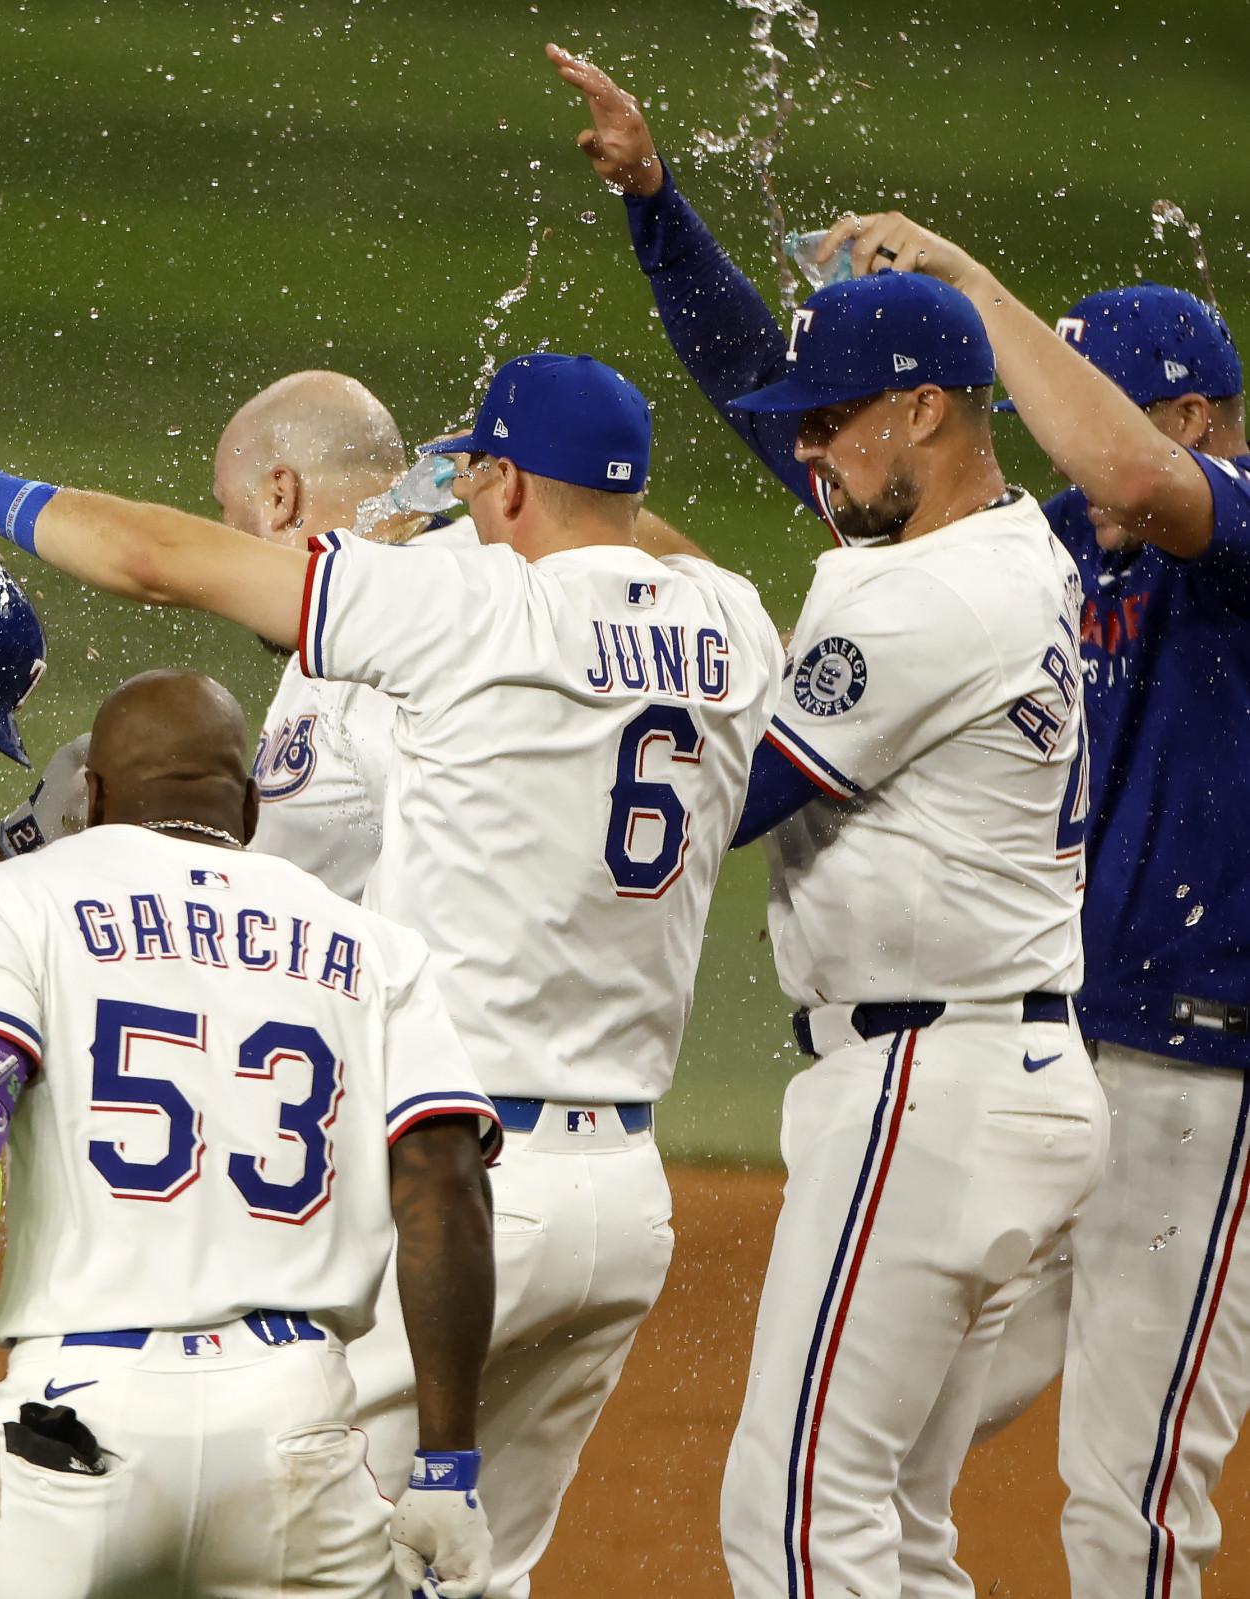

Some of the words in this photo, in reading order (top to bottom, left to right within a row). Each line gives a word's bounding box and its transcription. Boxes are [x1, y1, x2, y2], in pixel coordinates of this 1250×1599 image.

[7, 513, 15, 527] THE
[11, 487, 30, 513] RESULT
[584, 619, 729, 702] JUNG
[795, 663, 855, 716] TRANSFER
[818, 638, 867, 688] ENERGY
[602, 701, 706, 900] 6
[12, 822, 37, 849] 2
[73, 893, 362, 1001] GARCIA
[88, 997, 346, 1226] 53
